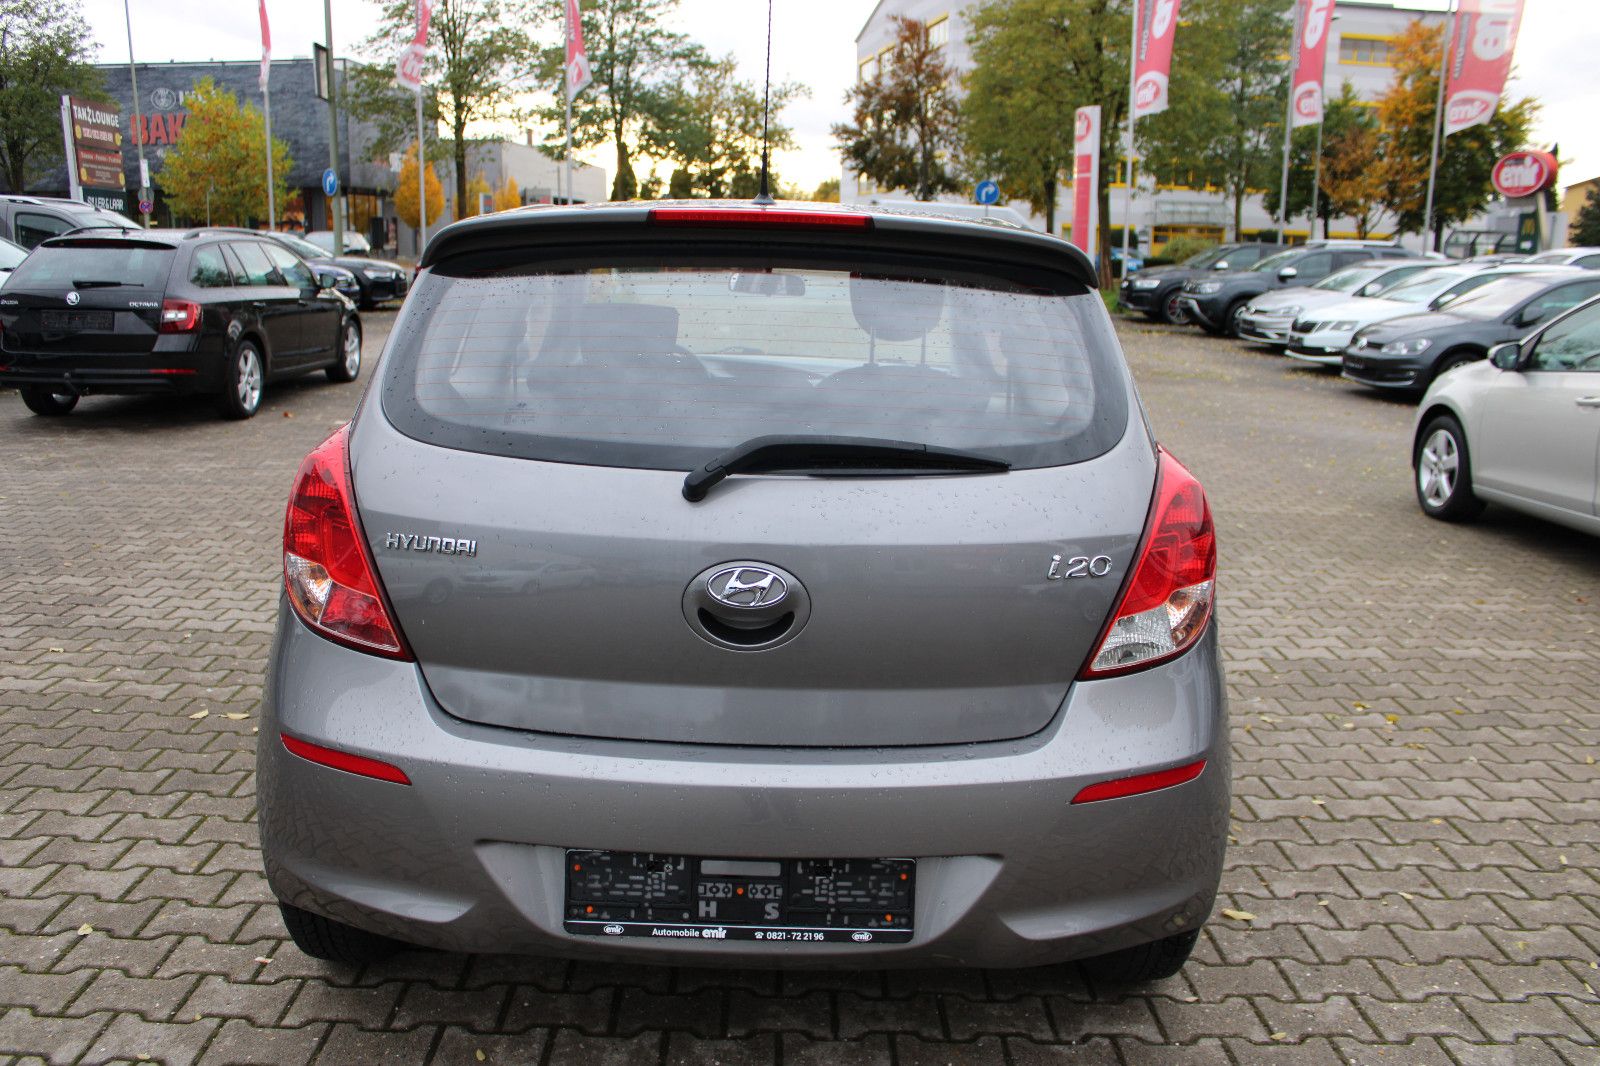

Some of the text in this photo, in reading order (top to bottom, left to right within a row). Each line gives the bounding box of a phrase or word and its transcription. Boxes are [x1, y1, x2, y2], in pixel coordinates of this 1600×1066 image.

[1499, 156, 1539, 188] emir
[386, 532, 477, 556] HYUNDAI
[1048, 554, 1112, 579] i20
[652, 927, 727, 939] Automobile emir
